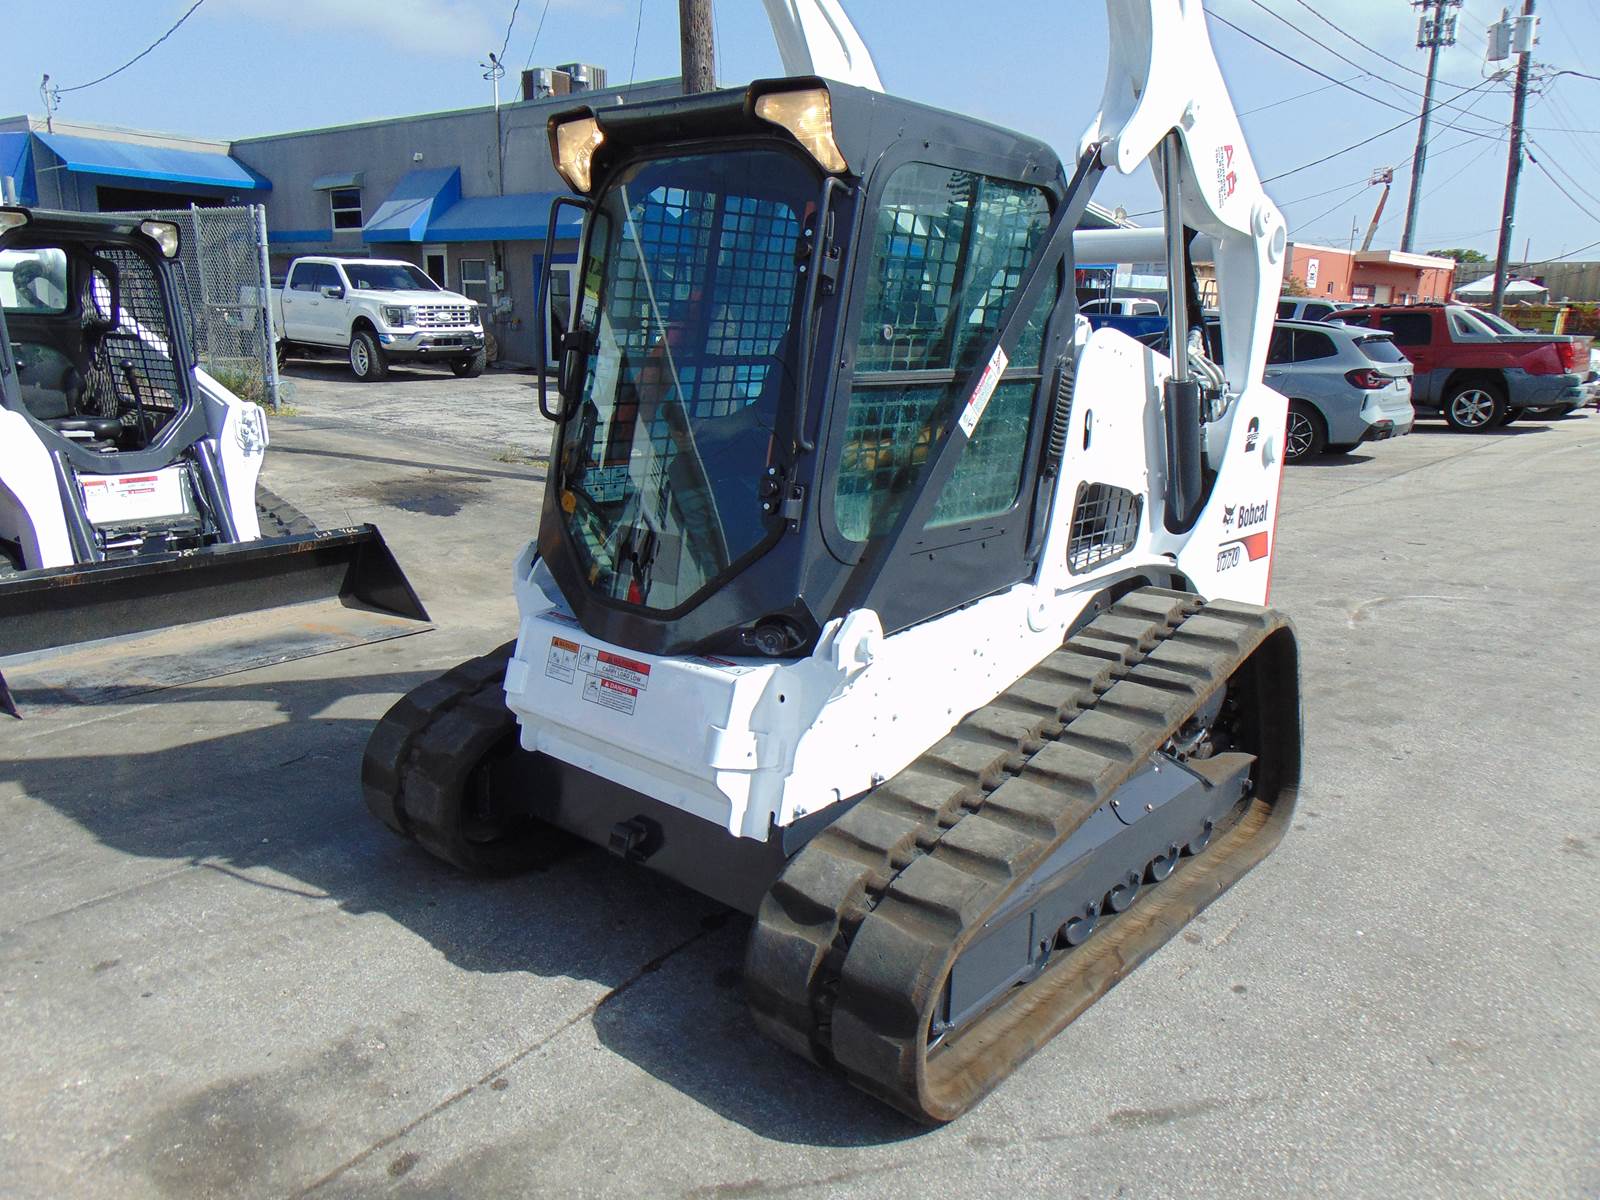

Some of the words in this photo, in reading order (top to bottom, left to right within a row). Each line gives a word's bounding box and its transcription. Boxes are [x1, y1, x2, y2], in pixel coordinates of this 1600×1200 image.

[1244, 416, 1259, 453] 2
[1238, 500, 1269, 529] Bobcat
[1216, 546, 1241, 573] T770
[610, 683, 633, 694] DANGER
